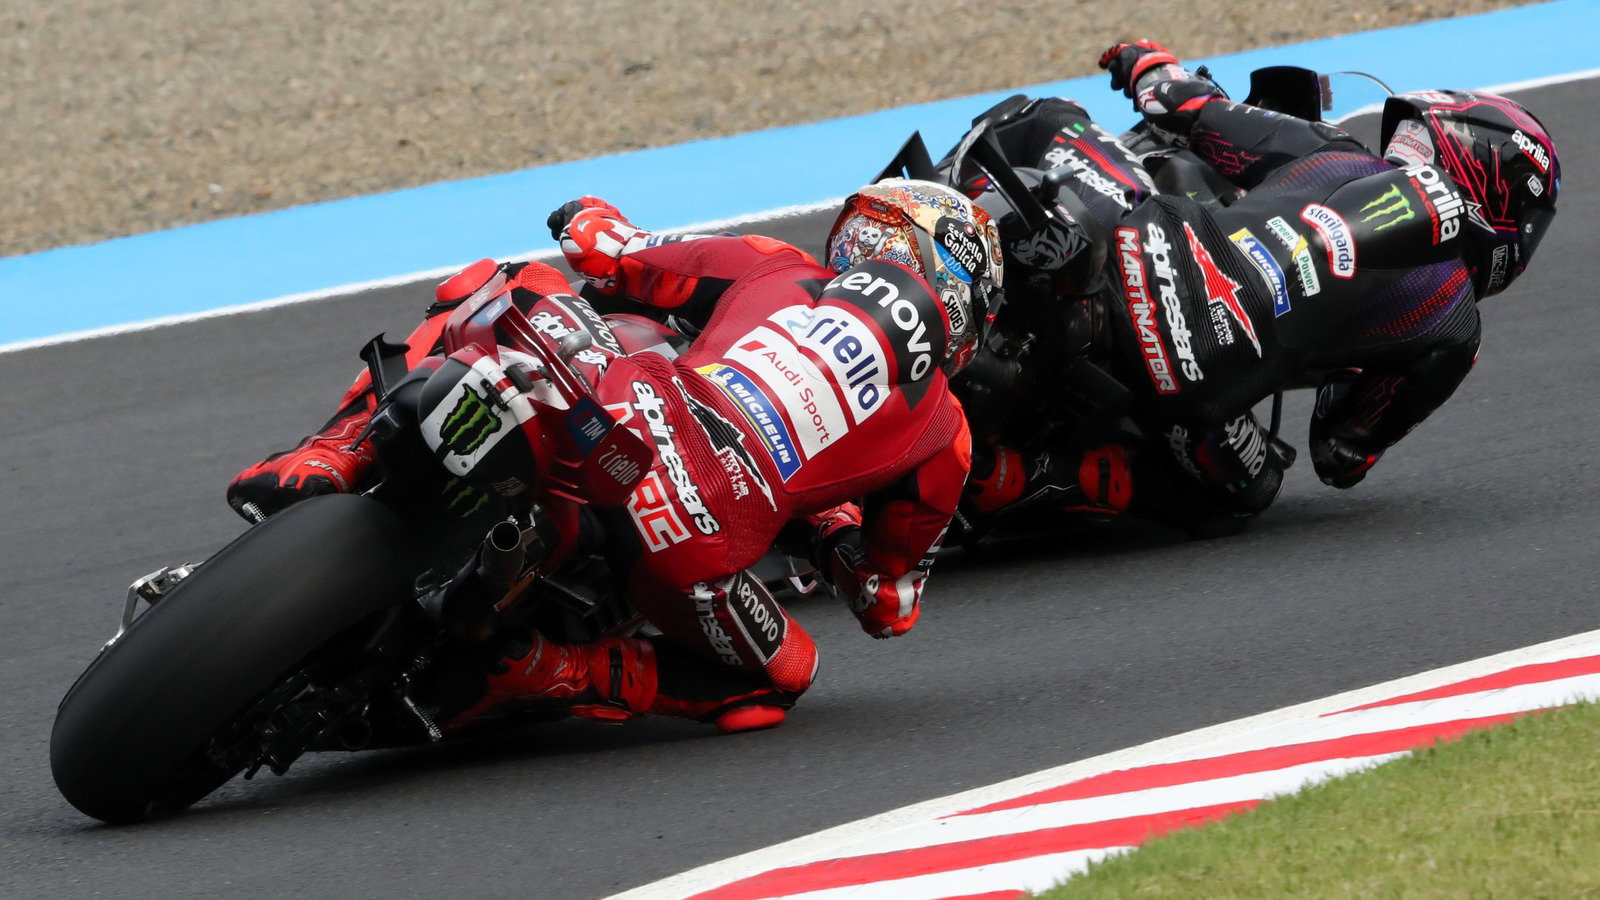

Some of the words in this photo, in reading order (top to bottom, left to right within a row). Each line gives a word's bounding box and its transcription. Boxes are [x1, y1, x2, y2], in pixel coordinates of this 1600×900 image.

[1511, 129, 1550, 171] aprilia
[944, 232, 977, 273] Galicia
[947, 223, 983, 264] Estrella
[1270, 217, 1294, 241] Green
[1299, 253, 1316, 291] Power
[1305, 206, 1350, 272] sterilgarda
[1143, 222, 1203, 382] alpinestars
[1252, 249, 1284, 306] MICHELIN
[944, 294, 964, 331] SHOEI
[1117, 229, 1178, 392] MARTINATOR
[805, 317, 880, 411] riello
[581, 416, 607, 441] TIM
[730, 382, 792, 465] MICHELIN
[762, 351, 804, 388] Audi
[801, 386, 830, 445] Sport
[604, 454, 641, 486] riello
[631, 381, 720, 536] alpinestars
[738, 578, 778, 642] Lenovo
